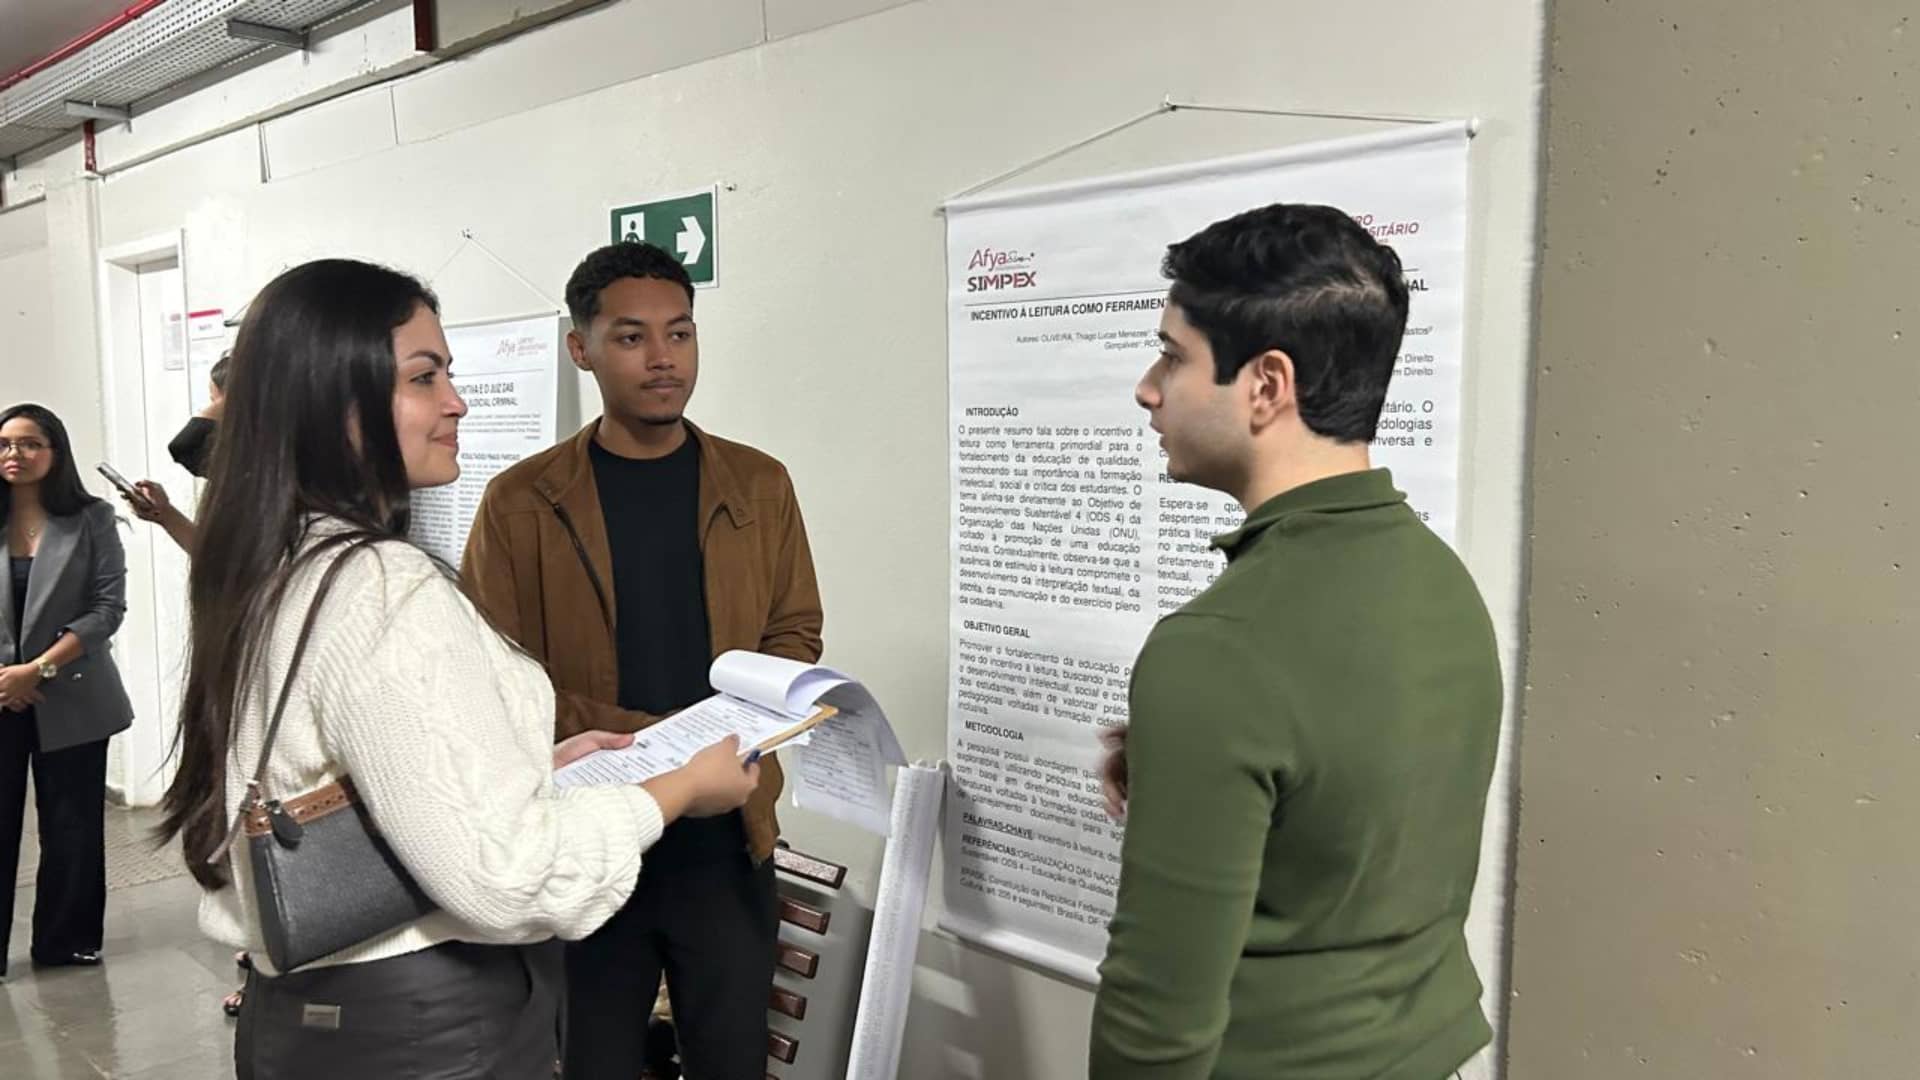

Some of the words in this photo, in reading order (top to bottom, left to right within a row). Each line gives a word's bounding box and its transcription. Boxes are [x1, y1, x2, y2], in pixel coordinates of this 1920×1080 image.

[969, 249, 1007, 272] Afya
[968, 272, 1036, 292] SIMPEX
[971, 308, 1017, 321] INCENTIVO
[1029, 305, 1069, 317] LEITURA
[1072, 303, 1103, 315] COMO
[966, 406, 1018, 418] INTRODUÇÃO
[1422, 401, 1433, 413] O
[959, 425, 965, 434] O
[969, 427, 1000, 436] presente
[1056, 427, 1079, 436] sobre
[1094, 427, 1132, 436] incentivo
[1012, 440, 1054, 449] ferramenta
[1060, 441, 1102, 452] primordial
[1109, 443, 1128, 452] para
[1425, 437, 1432, 446] e
[1016, 454, 1025, 462] da
[1032, 455, 1071, 465] educação
[1078, 455, 1089, 464] de
[1097, 456, 1141, 466] qualidade,
[1100, 470, 1142, 482] formação
[1061, 484, 1076, 492] dos
[1134, 485, 1141, 495] O
[1088, 498, 1123, 510] Objetivo
[1130, 500, 1141, 509] de
[1159, 498, 1208, 510] Espera-se
[1076, 512, 1081, 520] 4
[1116, 514, 1124, 524] 4)
[1130, 515, 1141, 524] da
[1159, 512, 1209, 525] despertem
[1011, 521, 1024, 530] das
[1033, 522, 1062, 534] Nações
[1051, 538, 1061, 547] de
[1098, 542, 1140, 554] educação
[1158, 542, 1170, 551] no
[1113, 559, 1129, 568] que
[1158, 556, 1214, 569] diretamente
[1134, 574, 1140, 582] o
[1021, 576, 1031, 585] da
[1128, 588, 1140, 597] da
[1060, 595, 1070, 603] do
[964, 620, 1001, 634] OBJETIVO
[1003, 626, 1030, 638] GERAL
[1079, 660, 1119, 674] educação
[966, 720, 1023, 741] METODOLOGIA
